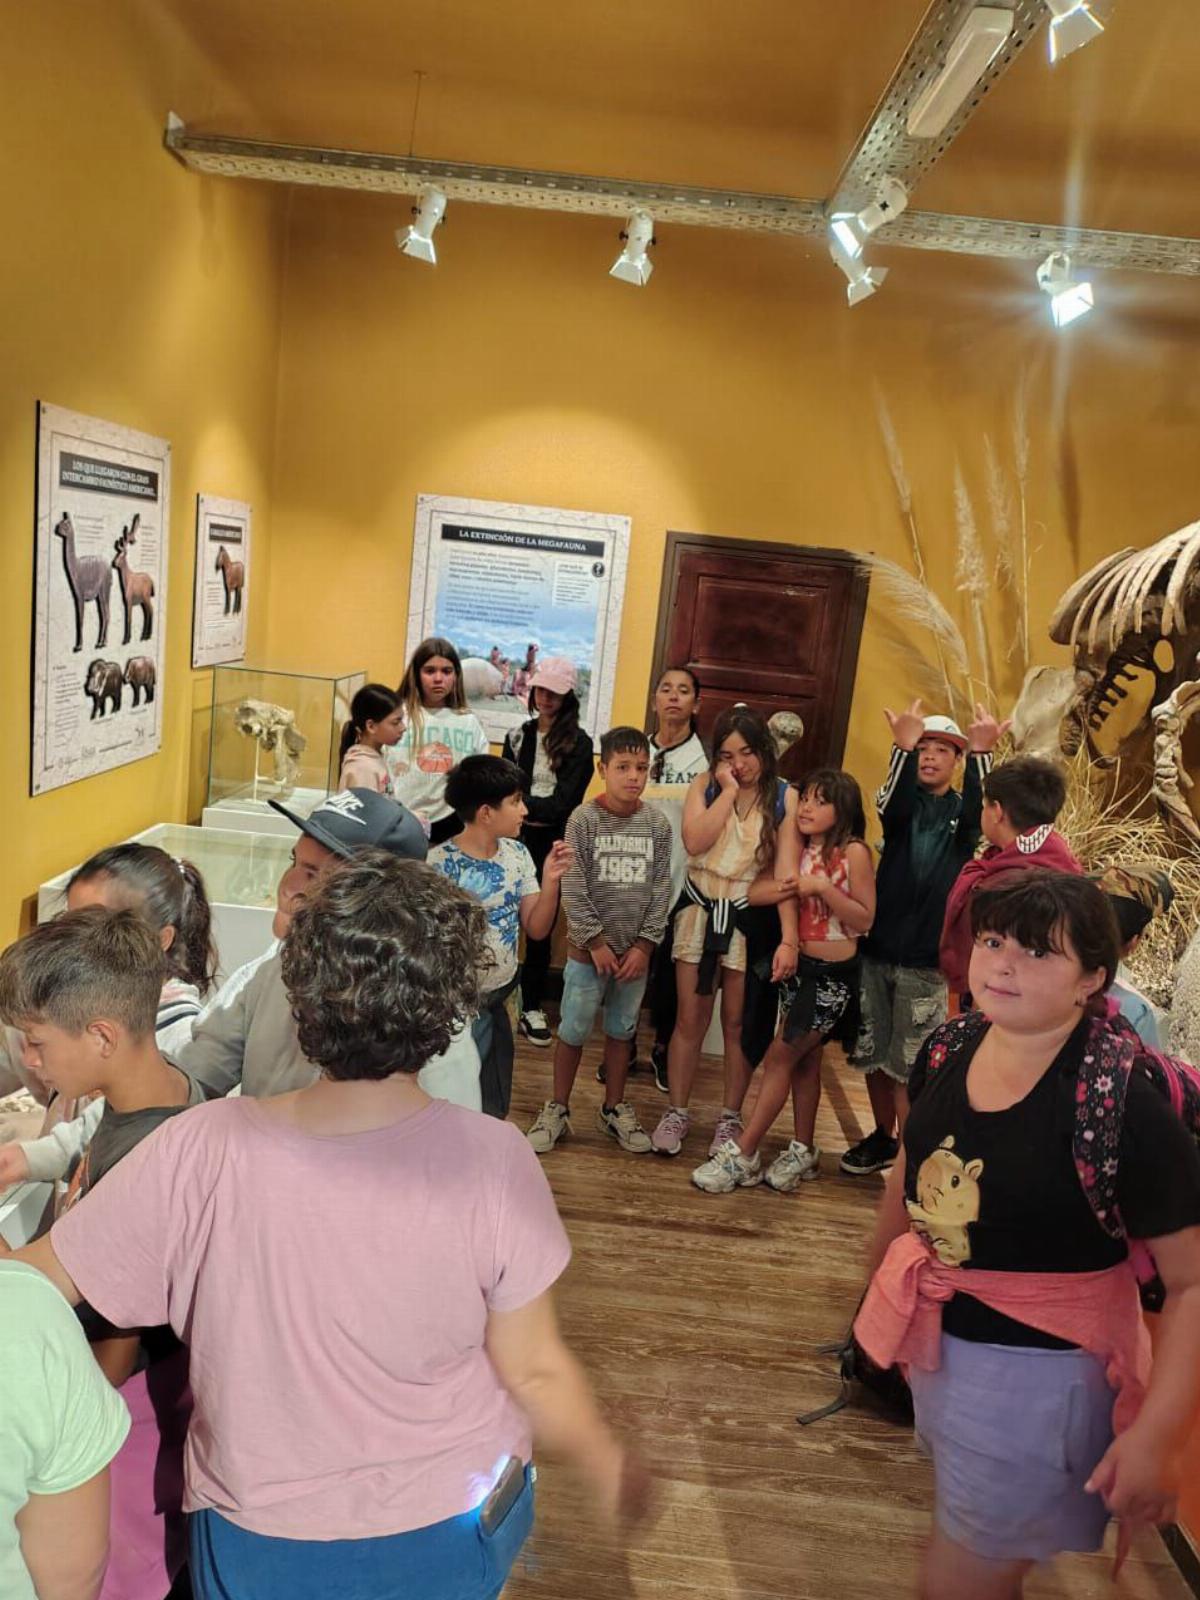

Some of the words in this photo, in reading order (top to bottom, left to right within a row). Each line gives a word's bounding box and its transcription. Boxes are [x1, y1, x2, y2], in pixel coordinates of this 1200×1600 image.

[459, 530, 469, 538] LA
[470, 531, 514, 544] EXTINCIÓN
[514, 536, 525, 544] DE
[526, 537, 537, 546] LA
[537, 538, 587, 552] MEGAFAUNA
[597, 856, 647, 882] 1962
